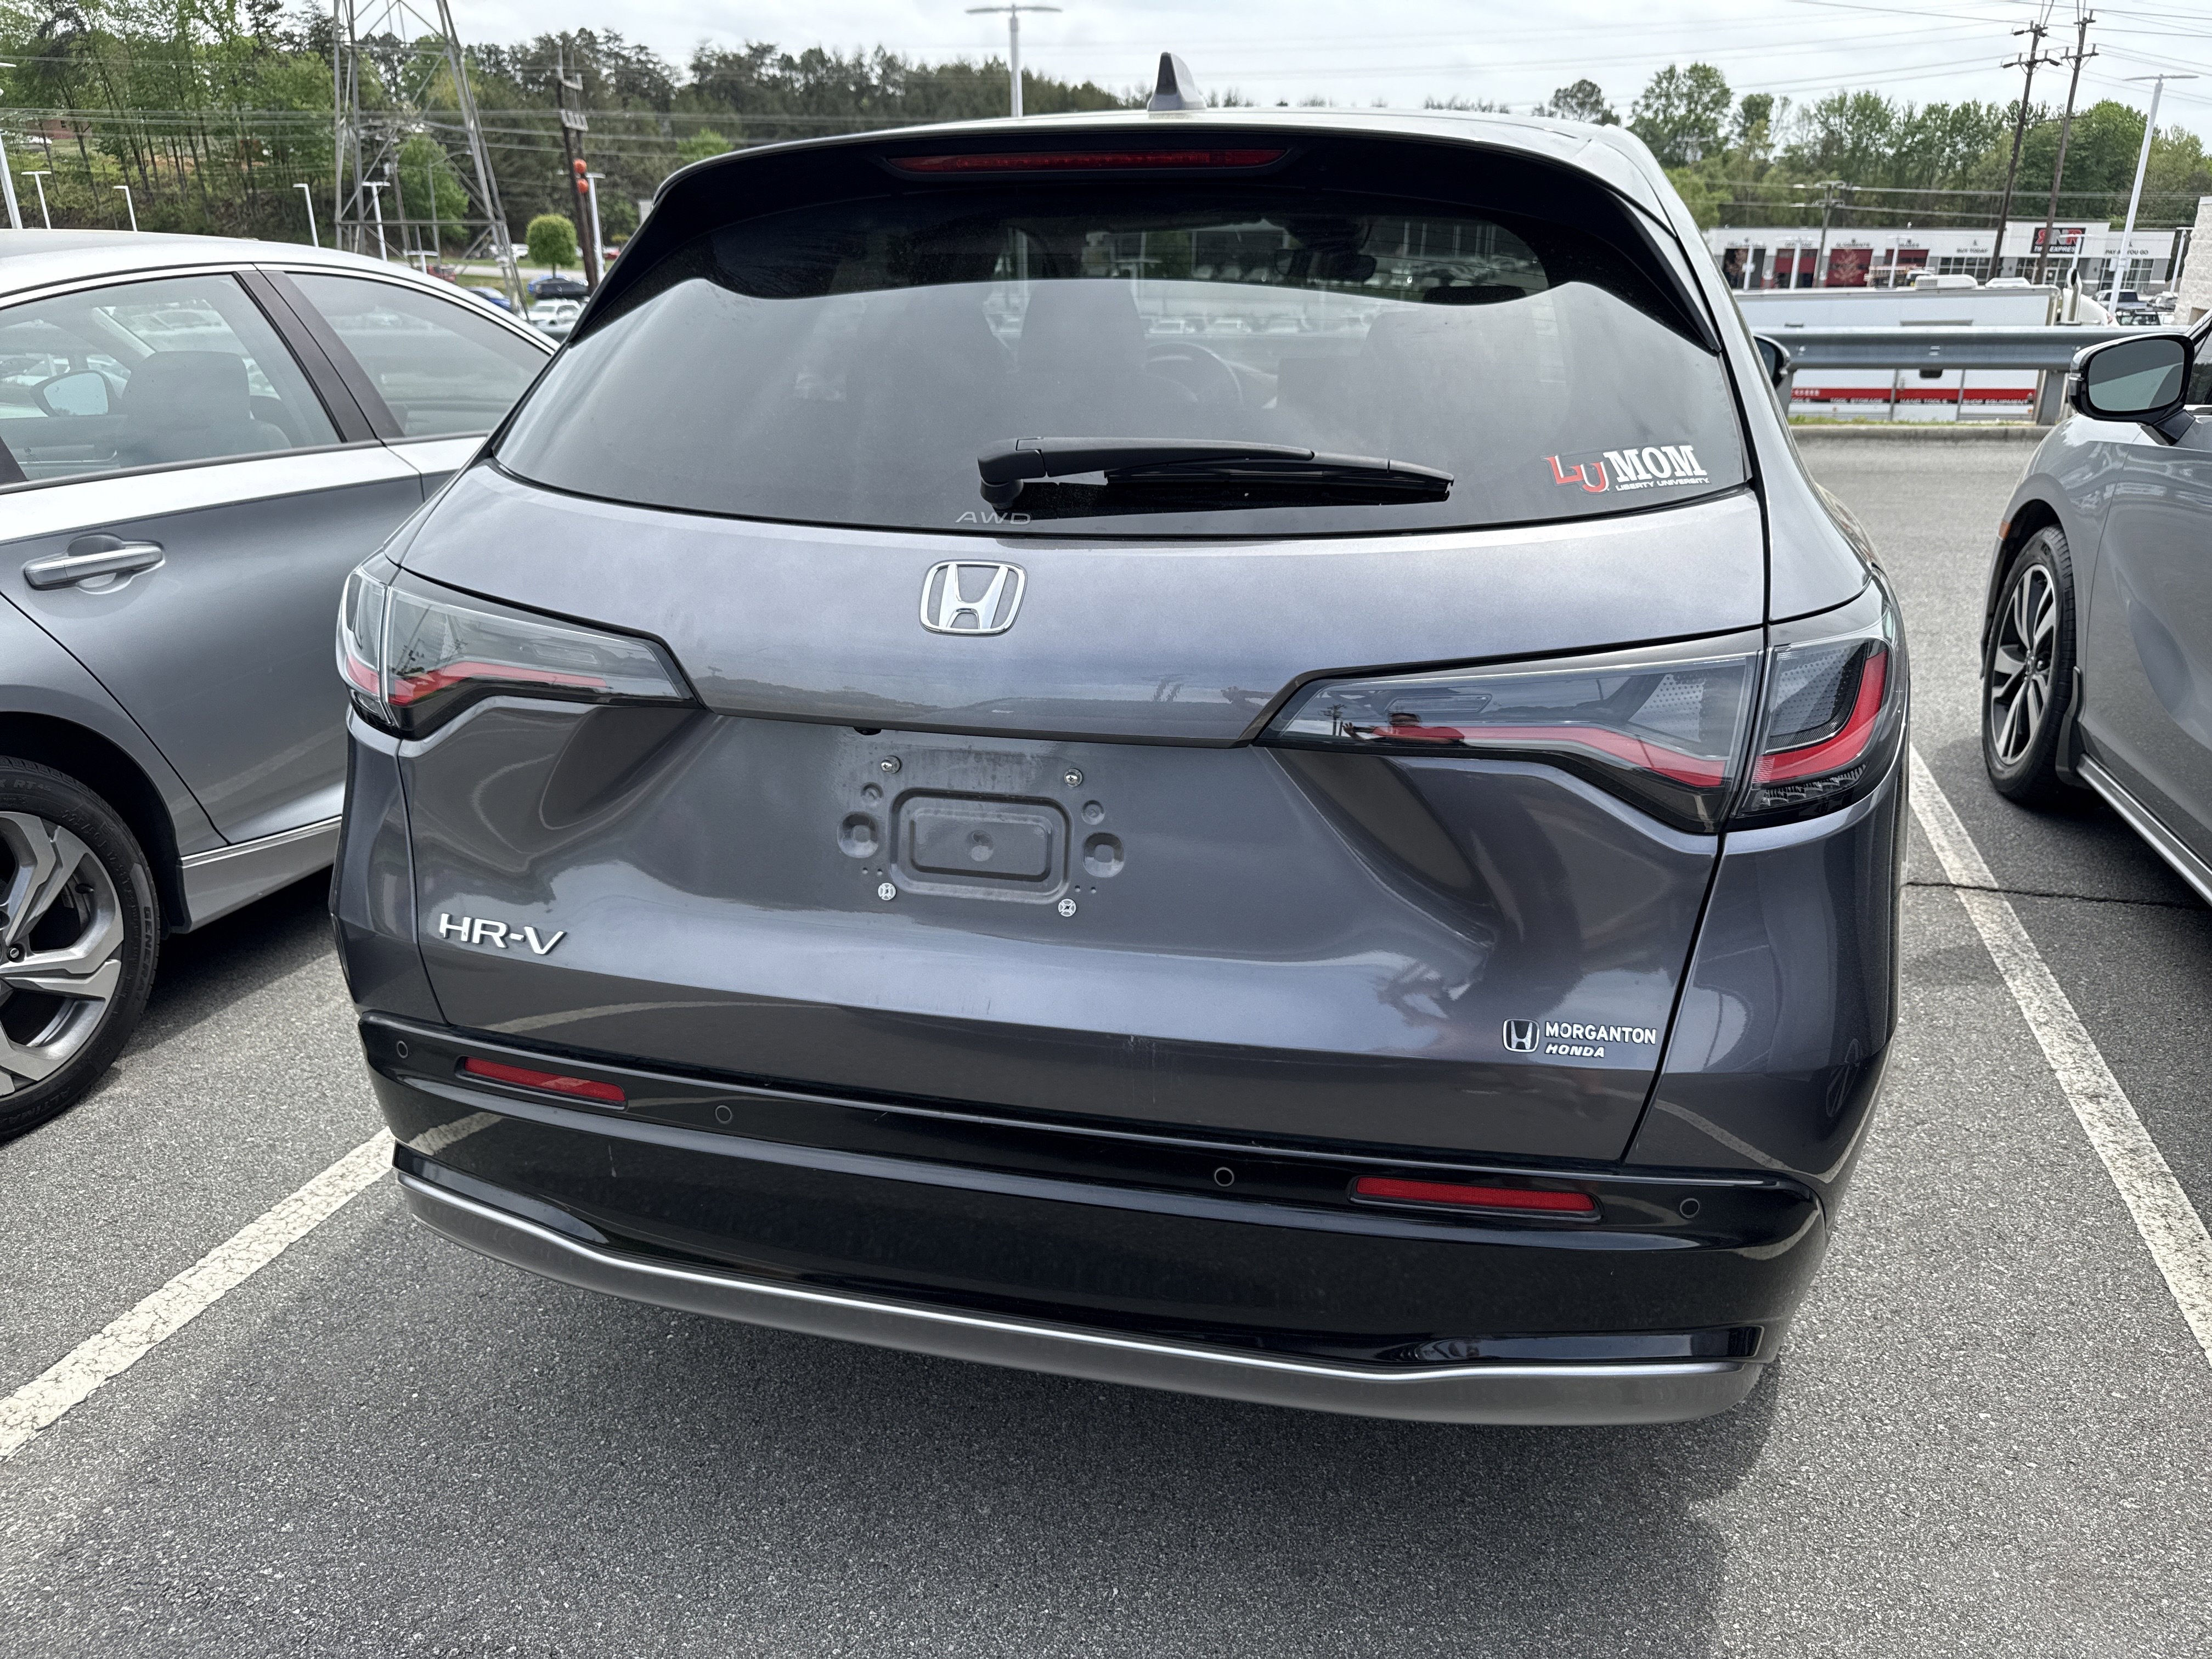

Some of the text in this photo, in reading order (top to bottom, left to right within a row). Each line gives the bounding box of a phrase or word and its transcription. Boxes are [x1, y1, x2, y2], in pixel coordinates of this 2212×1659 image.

[1544, 445, 1707, 493] LU MOM
[1615, 477, 1708, 492] LIBERTY UNIVERSITY
[955, 511, 1031, 525] AWD
[439, 913, 566, 955] HR-V
[1545, 1022, 1657, 1045] MORGANTON
[1545, 1043, 1605, 1058] HONDA
